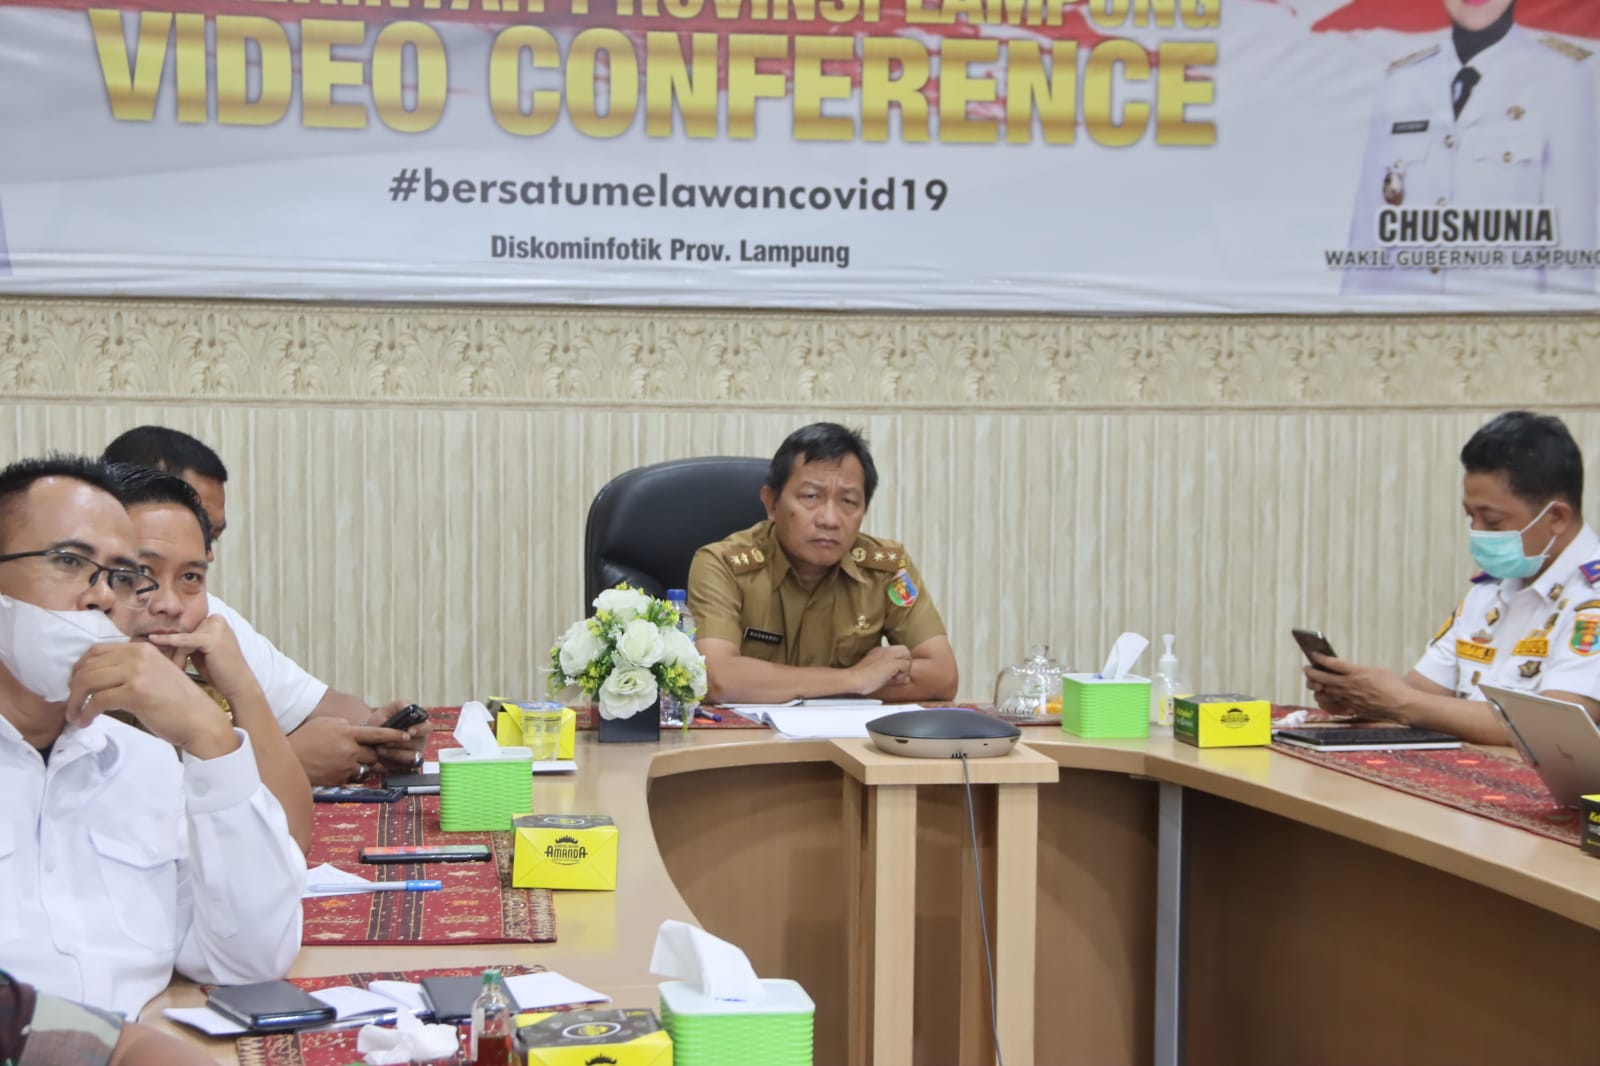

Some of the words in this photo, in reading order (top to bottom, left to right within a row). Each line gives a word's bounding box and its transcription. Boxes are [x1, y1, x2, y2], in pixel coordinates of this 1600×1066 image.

[88, 8, 448, 133] VIDEO
[489, 25, 1218, 147] CONFERENCE
[389, 168, 948, 211] #bersatumelawancovid19
[1378, 208, 1554, 243] CHUSNUNIA
[491, 235, 662, 261] Diskominfotik
[670, 239, 731, 262] Prov.
[740, 239, 850, 269] Lampung
[1325, 250, 1390, 266] WAKIL
[1397, 250, 1505, 266] GUBERNUR
[544, 845, 588, 859] AMANDA
